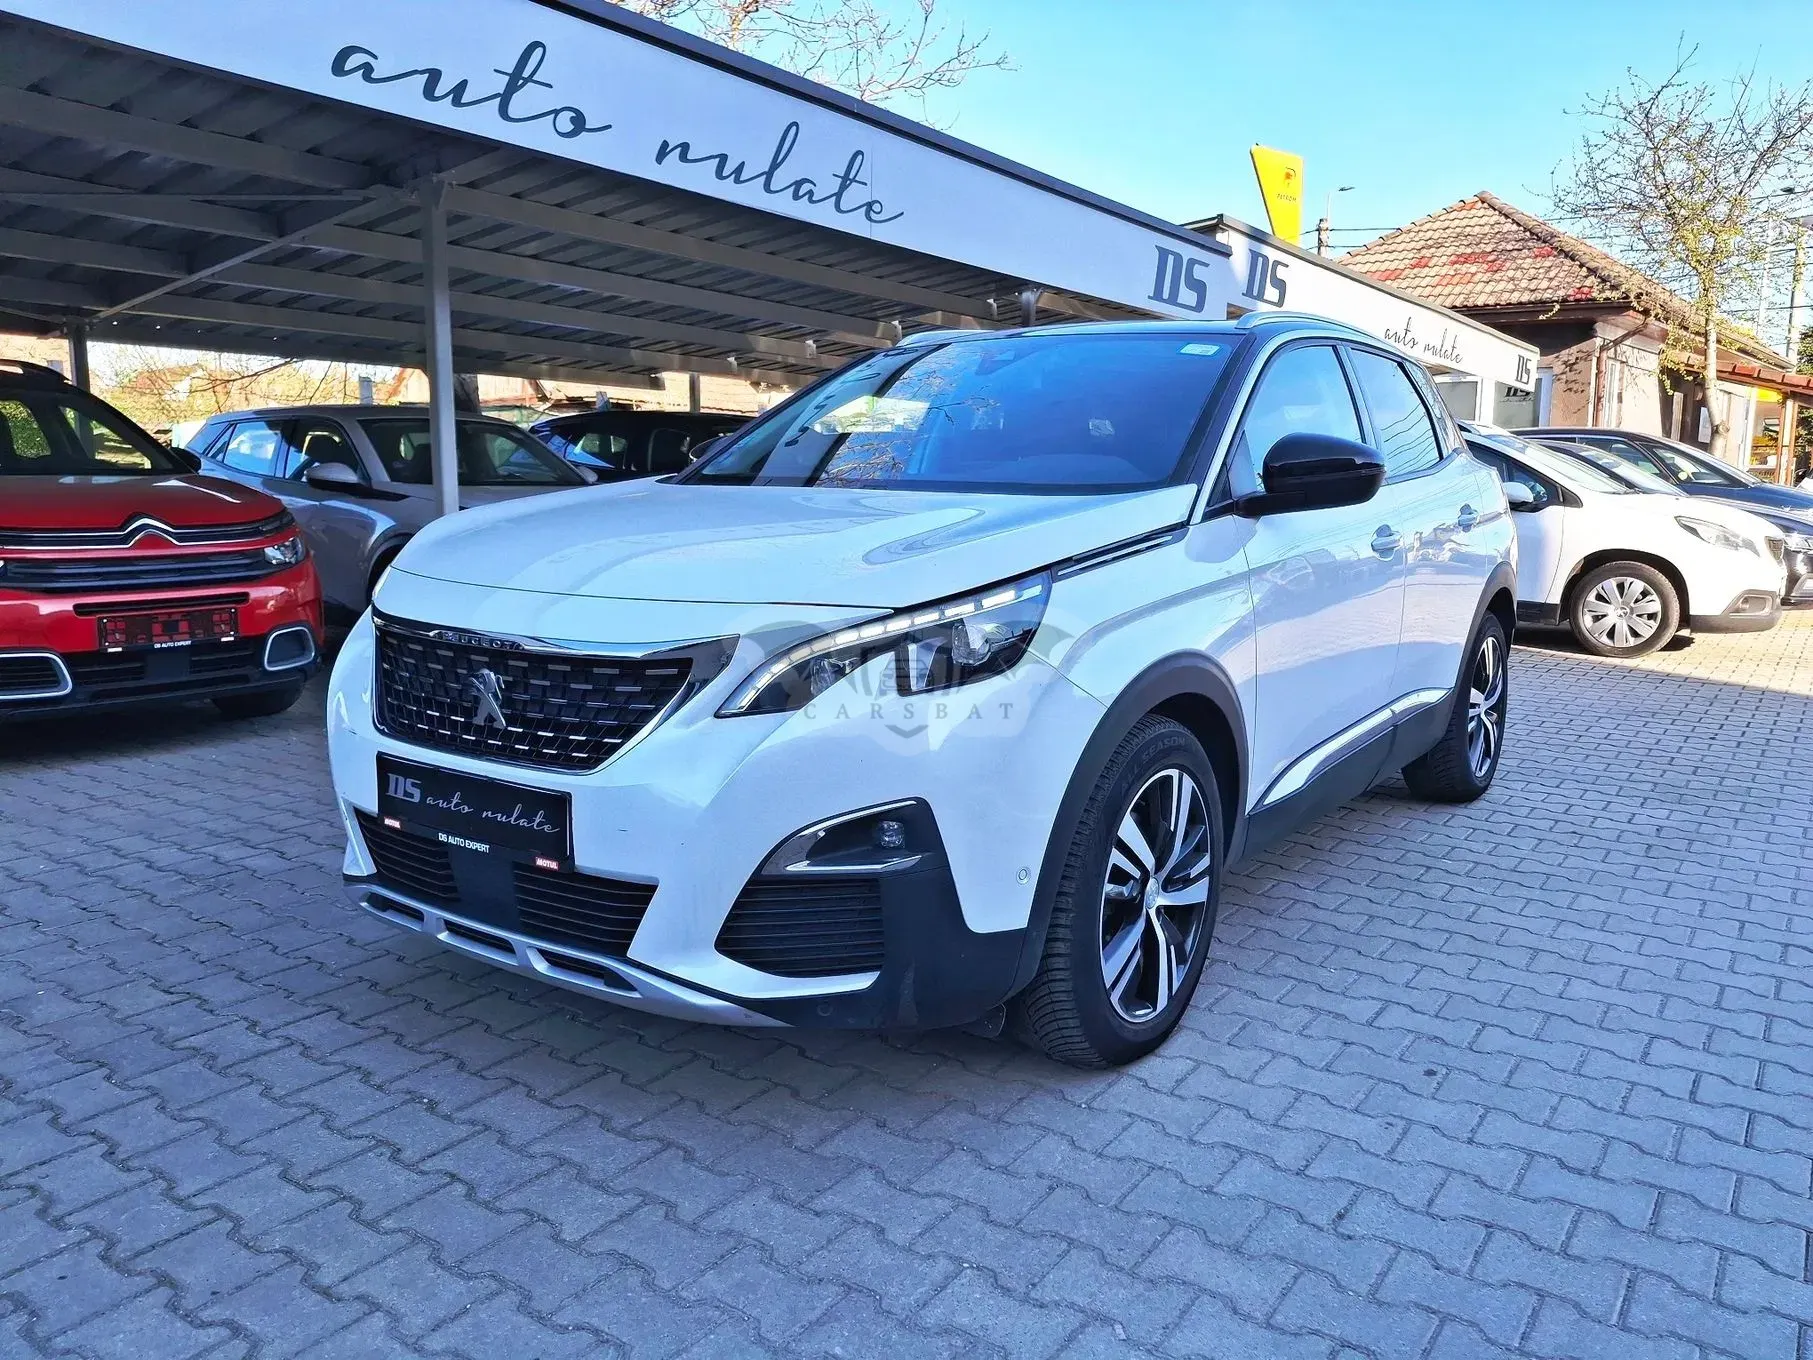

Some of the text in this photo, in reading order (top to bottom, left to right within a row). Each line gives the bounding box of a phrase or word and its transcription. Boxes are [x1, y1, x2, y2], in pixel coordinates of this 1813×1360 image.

[331, 40, 612, 138] auto
[1147, 244, 1211, 314] DS
[1241, 248, 1290, 309] DS
[1384, 316, 1419, 349] auto
[1515, 354, 1532, 385] DS
[385, 773, 421, 803] DS
[426, 791, 474, 814] auto
[438, 832, 490, 853] DS AUTO EXPERT
[535, 857, 559, 870] MOTUL
